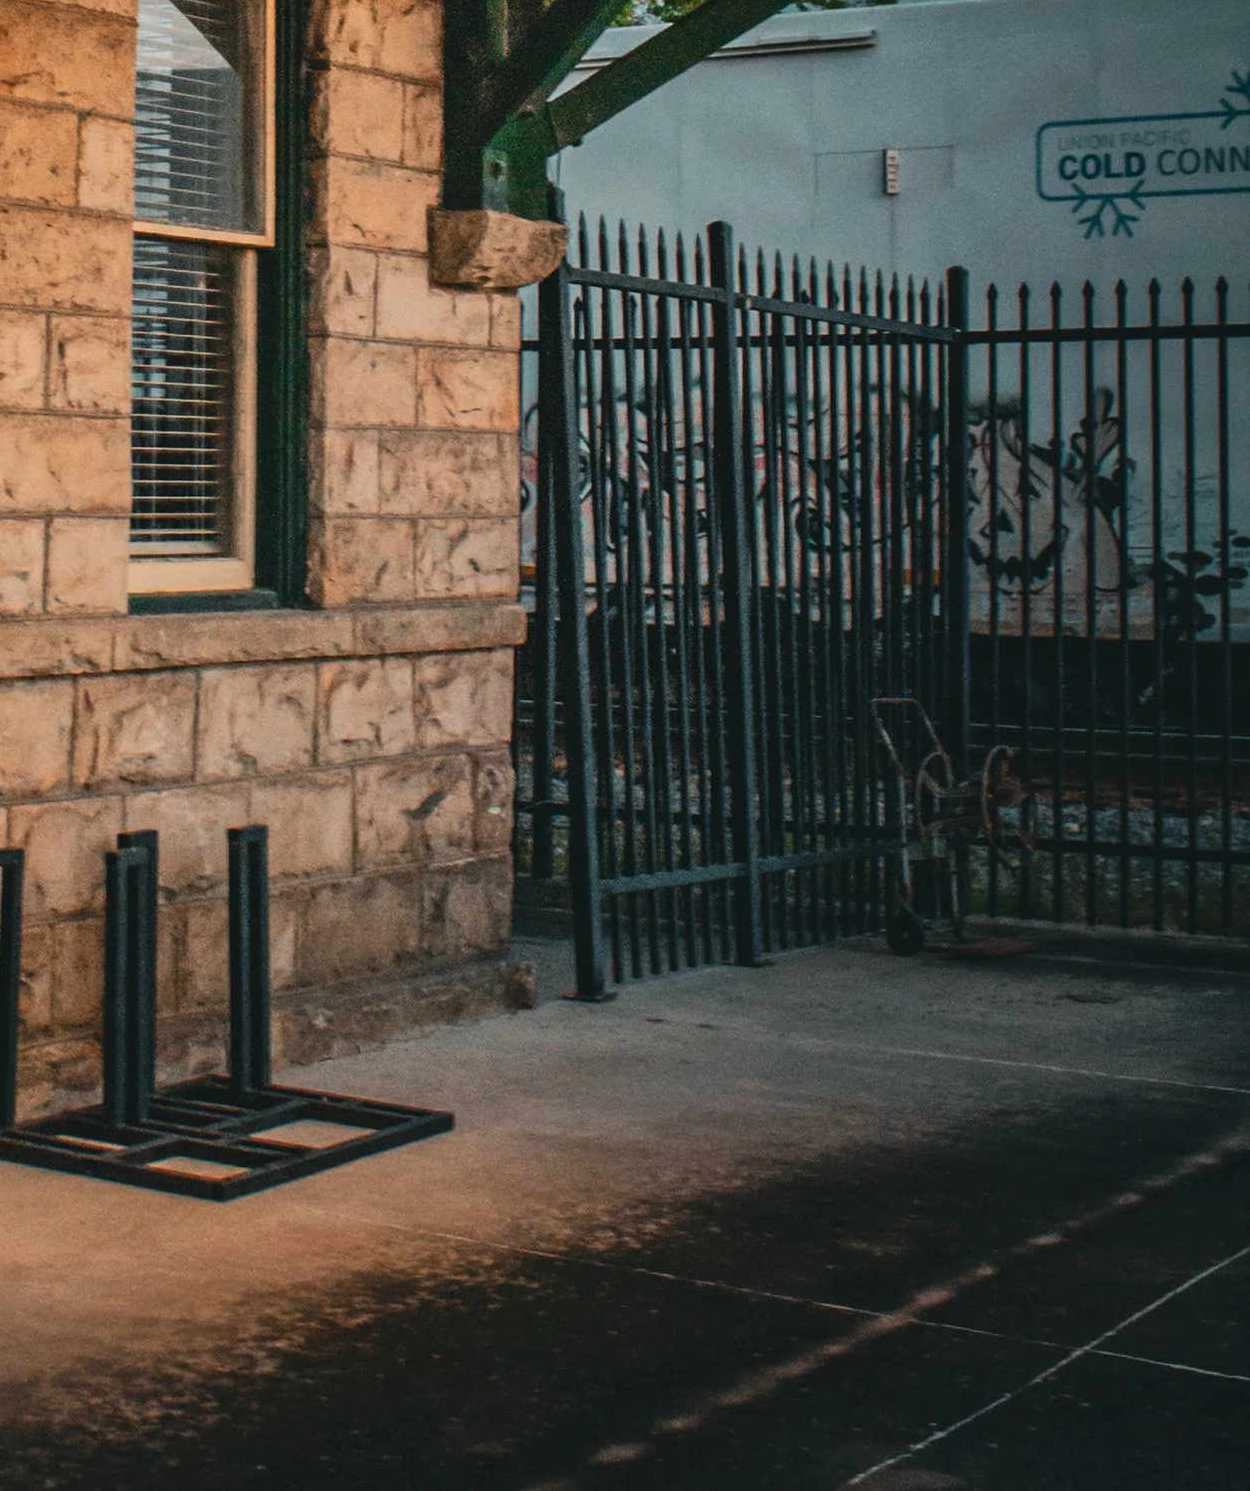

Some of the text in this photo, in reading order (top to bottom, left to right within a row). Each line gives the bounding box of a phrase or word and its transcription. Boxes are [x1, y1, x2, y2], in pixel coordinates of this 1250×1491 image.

[1058, 128, 1191, 151] UNION PACIFIC
[1058, 146, 1250, 180] COLD CONN
